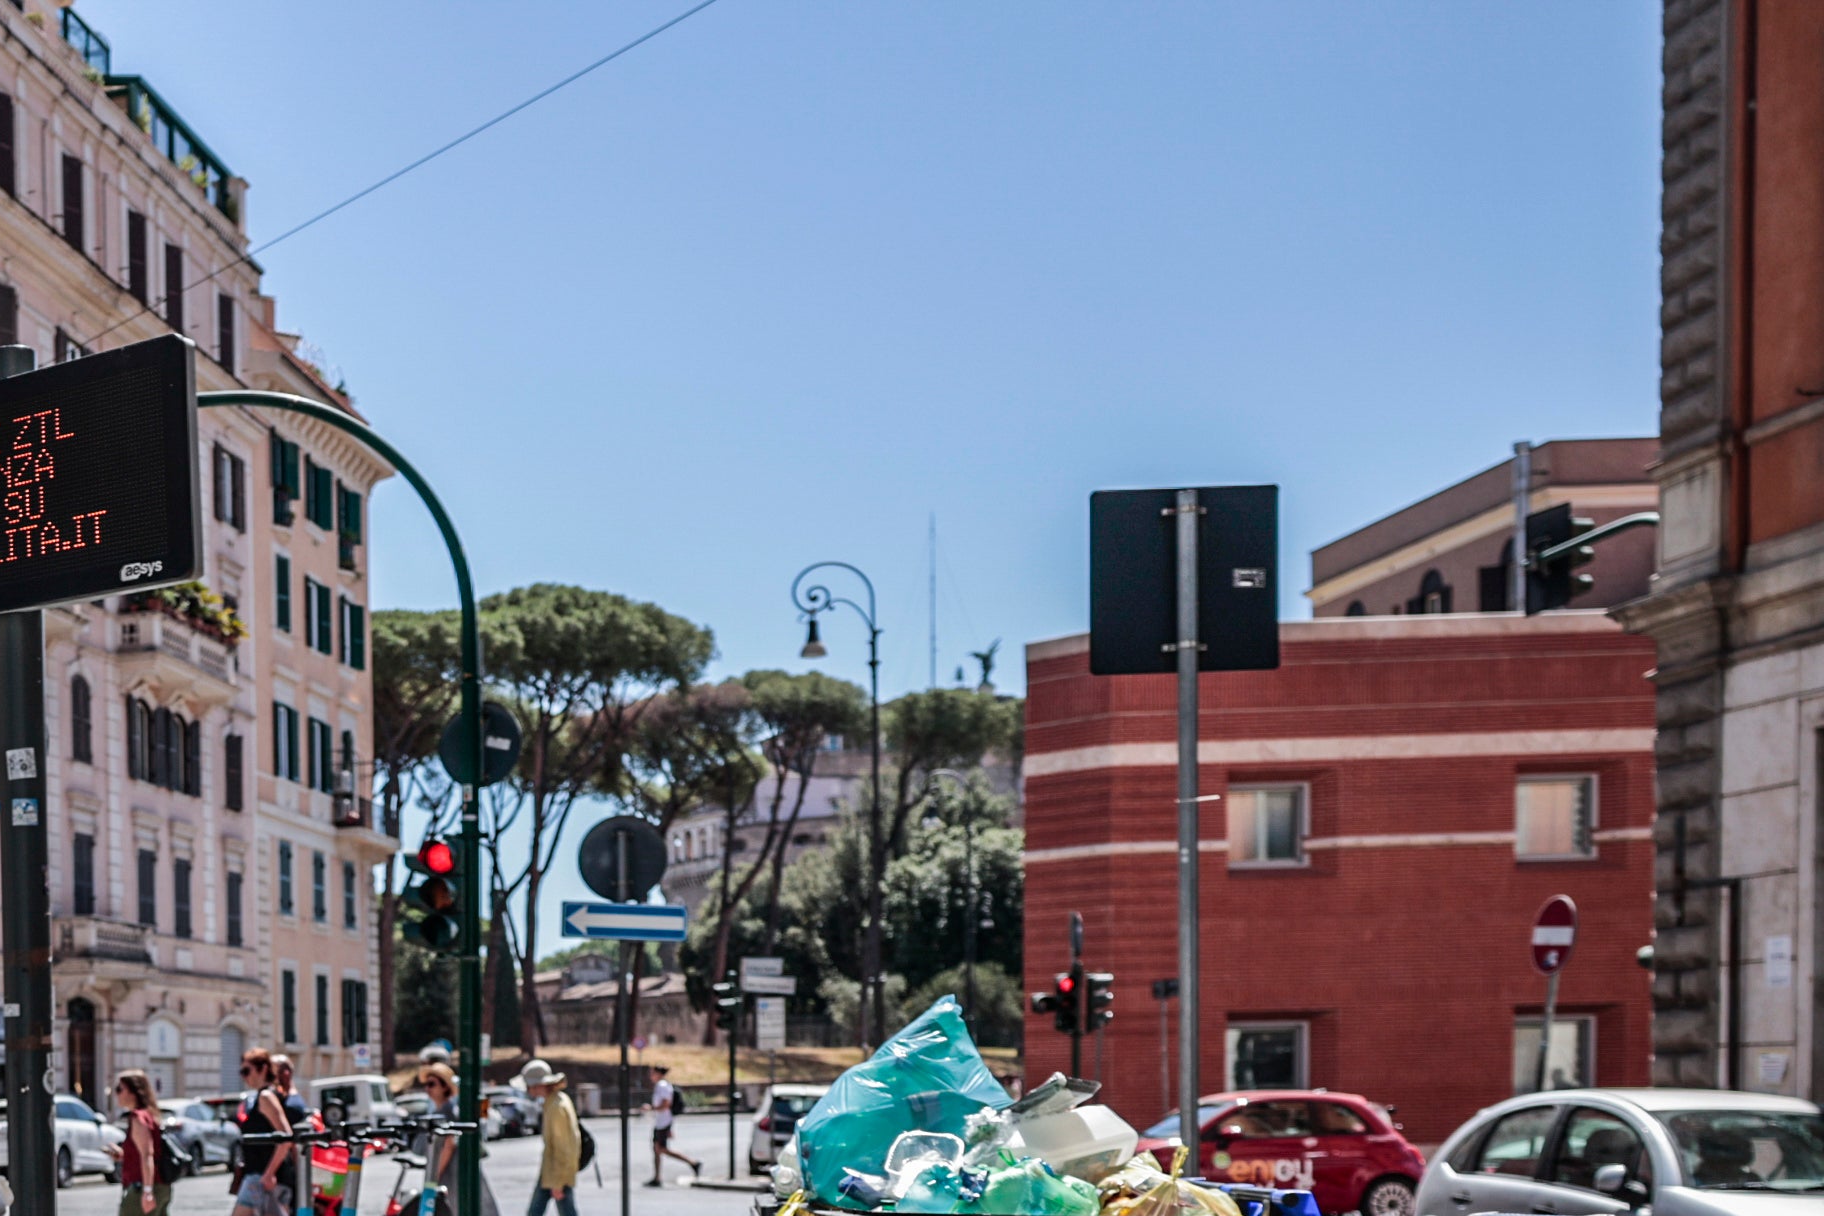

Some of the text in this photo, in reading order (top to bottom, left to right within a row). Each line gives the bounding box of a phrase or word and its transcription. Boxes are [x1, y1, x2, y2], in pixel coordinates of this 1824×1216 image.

[12, 408, 75, 450] ZTL
[4, 485, 45, 524] SU
[121, 560, 163, 581] aesys
